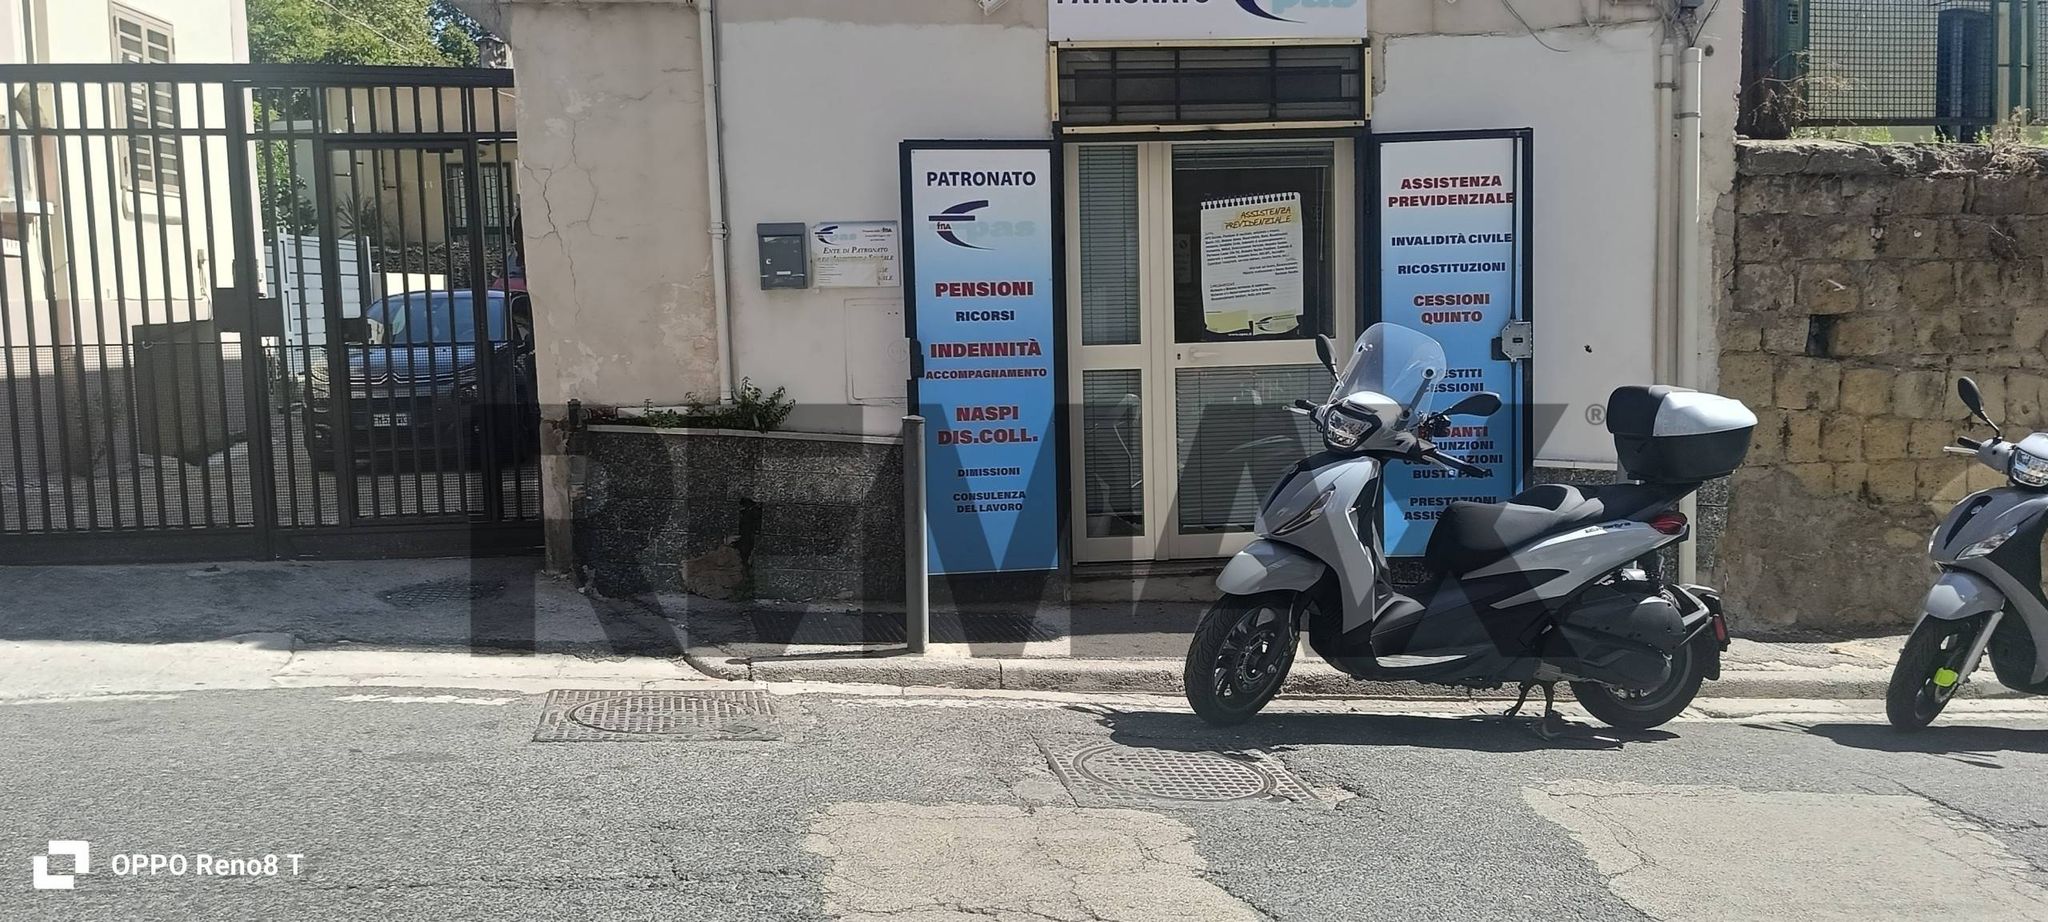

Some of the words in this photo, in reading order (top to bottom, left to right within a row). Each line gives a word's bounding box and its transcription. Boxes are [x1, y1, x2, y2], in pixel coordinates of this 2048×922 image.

[927, 172, 1036, 186] PATRONATO
[1401, 175, 1502, 190] ASSISTENZA
[1388, 192, 1515, 207] PREVIDENZIALE
[1240, 207, 1291, 219] ASSISTENZA
[1224, 215, 1292, 229] PREVIDENZIALE
[1391, 233, 1466, 246] INVALIDITÀ
[1468, 233, 1512, 244] CIVILE
[1398, 262, 1506, 275] RICOSTITUZIONI
[935, 281, 1034, 297] PENSIONI
[1413, 293, 1490, 306] CESSIONI
[956, 311, 1015, 322] RICORSI
[1421, 311, 1483, 325] QUINTO
[930, 338, 1042, 358] INDENNITÀ
[926, 369, 1047, 380] ACCOMPAGNAMENTO
[956, 406, 1019, 422] NASPI
[938, 428, 1039, 445] DIS.COLL.
[957, 467, 1021, 477] DIMISSIONI
[953, 491, 1026, 502] CONSULENZA
[957, 504, 977, 514] DEL
[979, 502, 1023, 512] LAVORO
